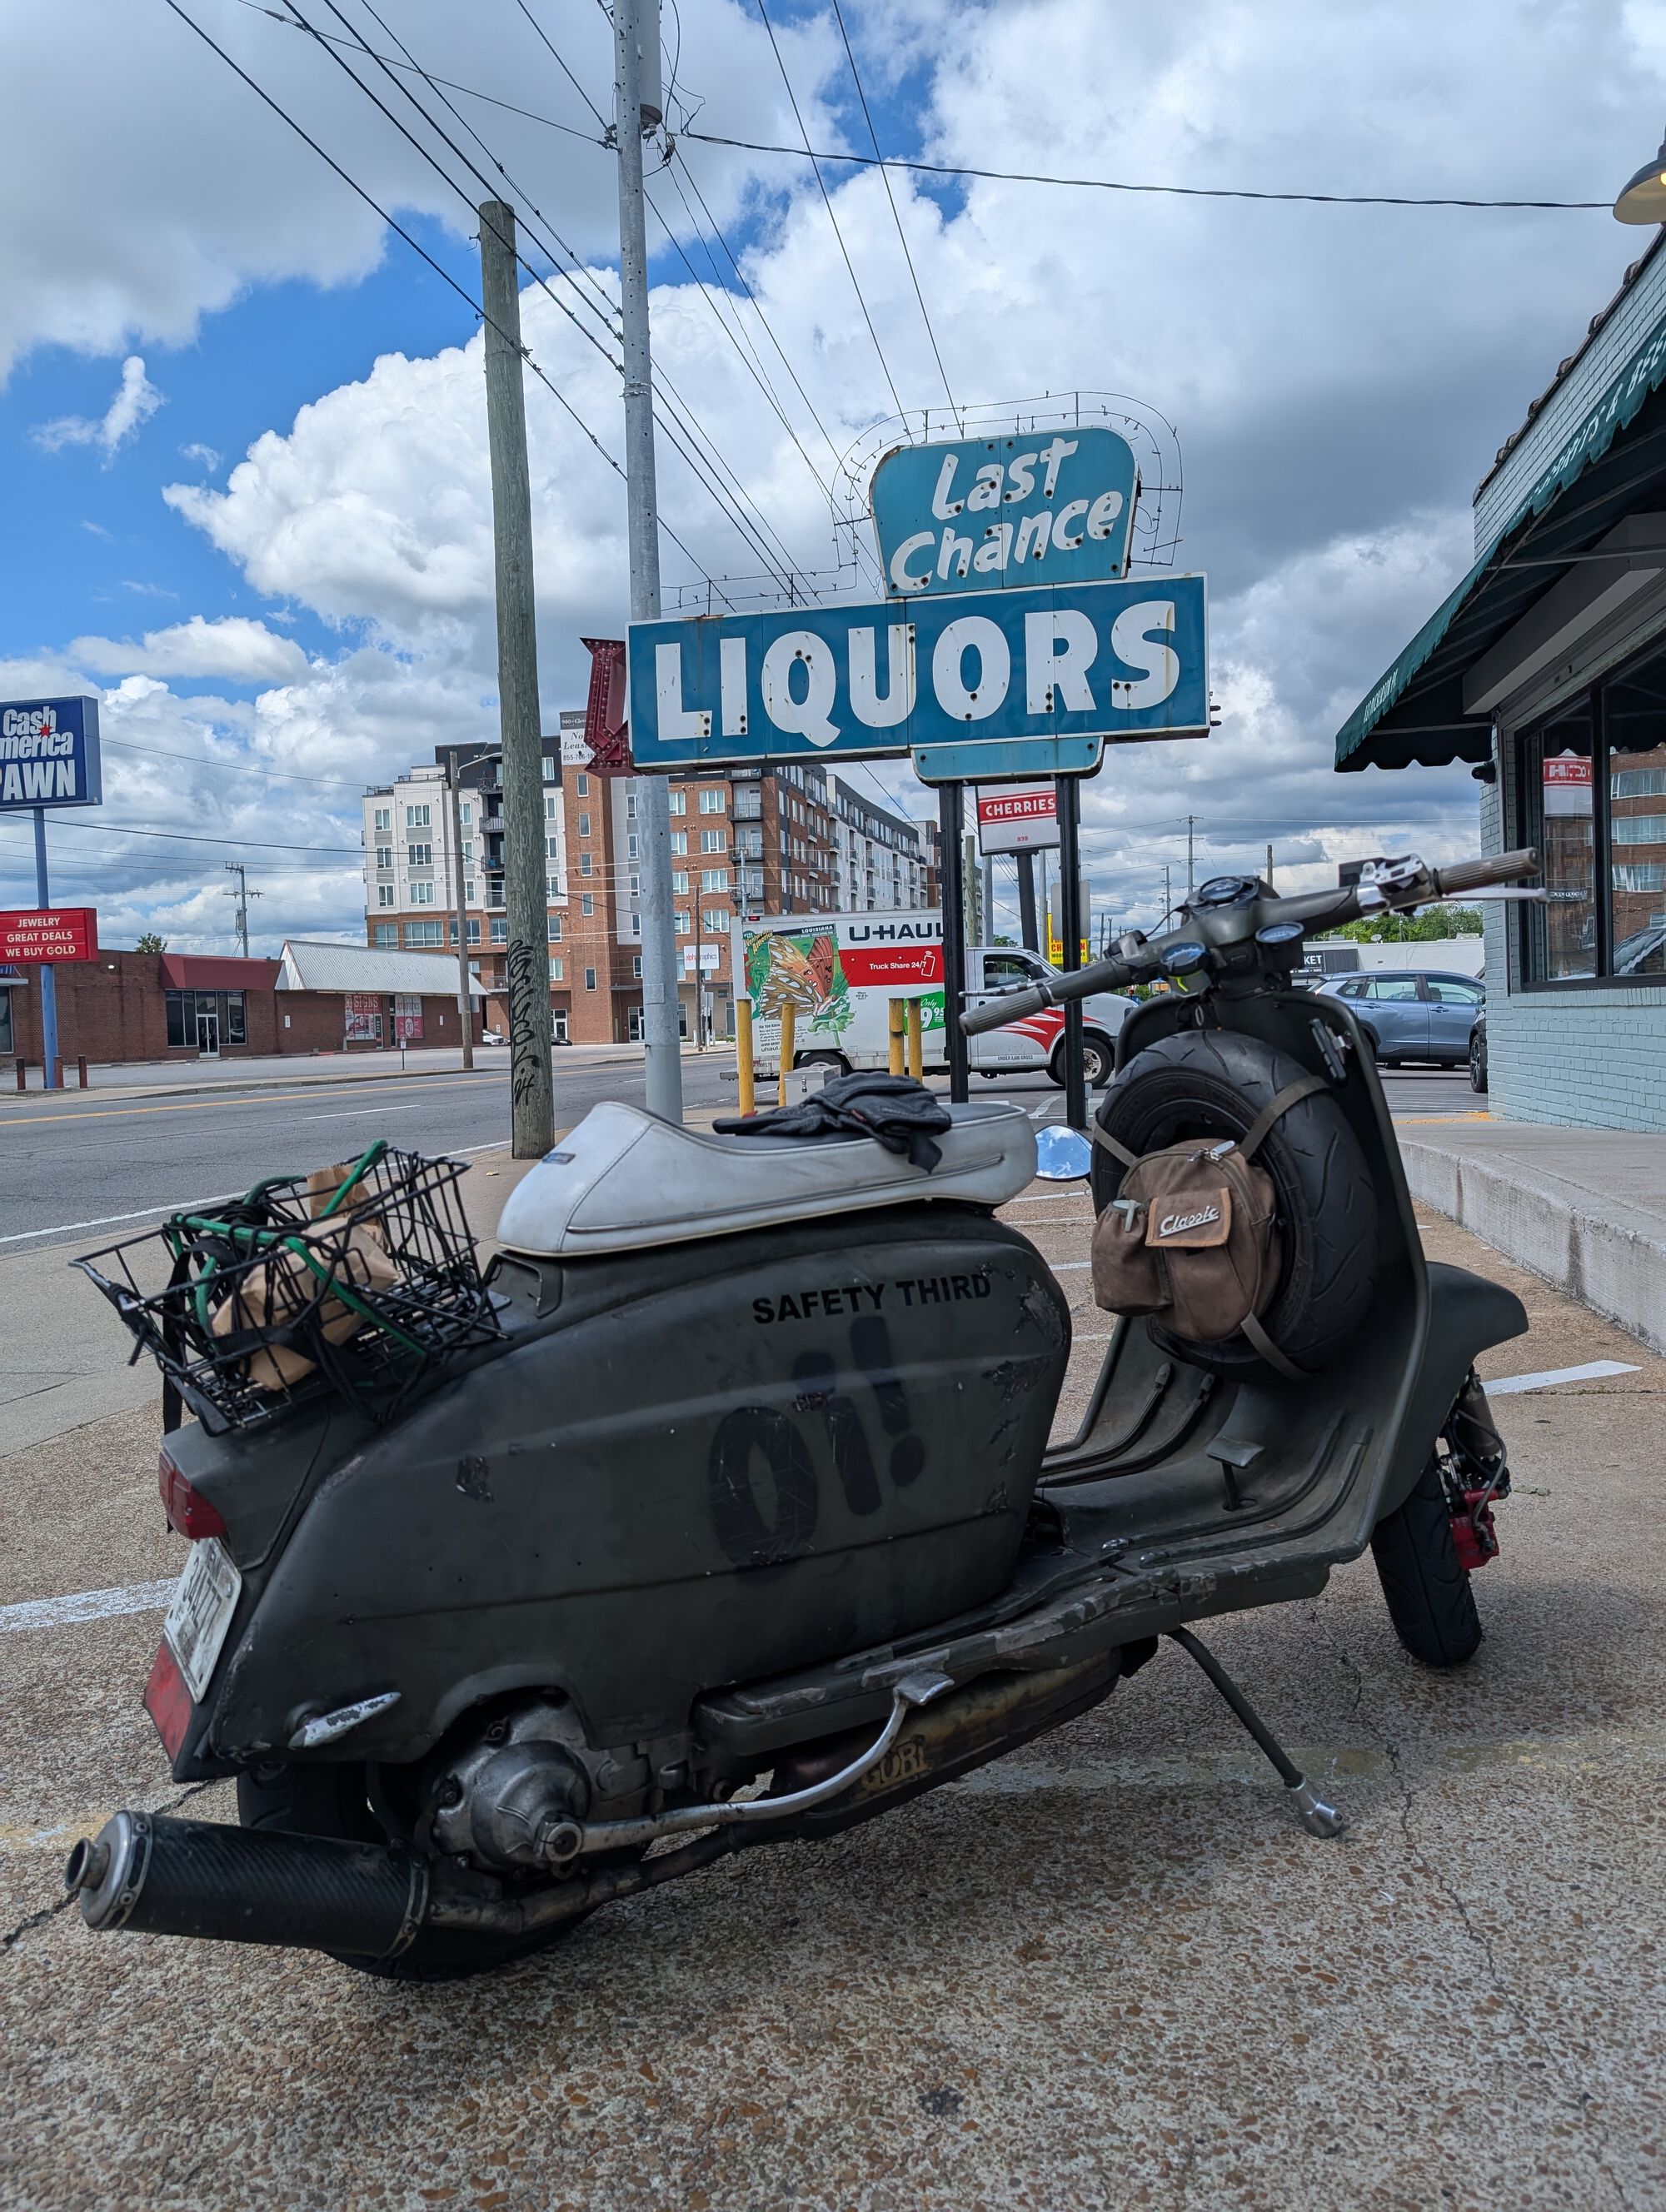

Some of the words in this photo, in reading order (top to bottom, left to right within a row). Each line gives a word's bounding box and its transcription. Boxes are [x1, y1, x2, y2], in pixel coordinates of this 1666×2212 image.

[1625, 327, 1666, 400] BEE
[932, 438, 1079, 521] Last
[890, 491, 1124, 590] Chance
[655, 600, 1180, 748] LIQUORS
[3, 706, 57, 737] Cash
[0, 731, 73, 760] merica
[571, 732, 583, 740] No
[0, 760, 76, 800] AWN
[985, 798, 1055, 816] CHERRIES
[17, 917, 60, 928] JEWELRY
[801, 925, 833, 934] LOUISIANA
[849, 922, 944, 942] U-HAUL
[7, 933, 39, 943] GREAT
[42, 931, 73, 941] DEALS
[6, 948, 21, 957] WE
[23, 947, 44, 956] BUY
[47, 945, 76, 955] GOLD
[1304, 955, 1322, 964] KET
[911, 960, 927, 969] 24/7
[353, 995, 378, 1008] SIGNS
[920, 999, 936, 1008] Only
[1160, 1205, 1220, 1238] Classic
[752, 1283, 885, 1324] SAFETY
[895, 1273, 991, 1306] THIRD
